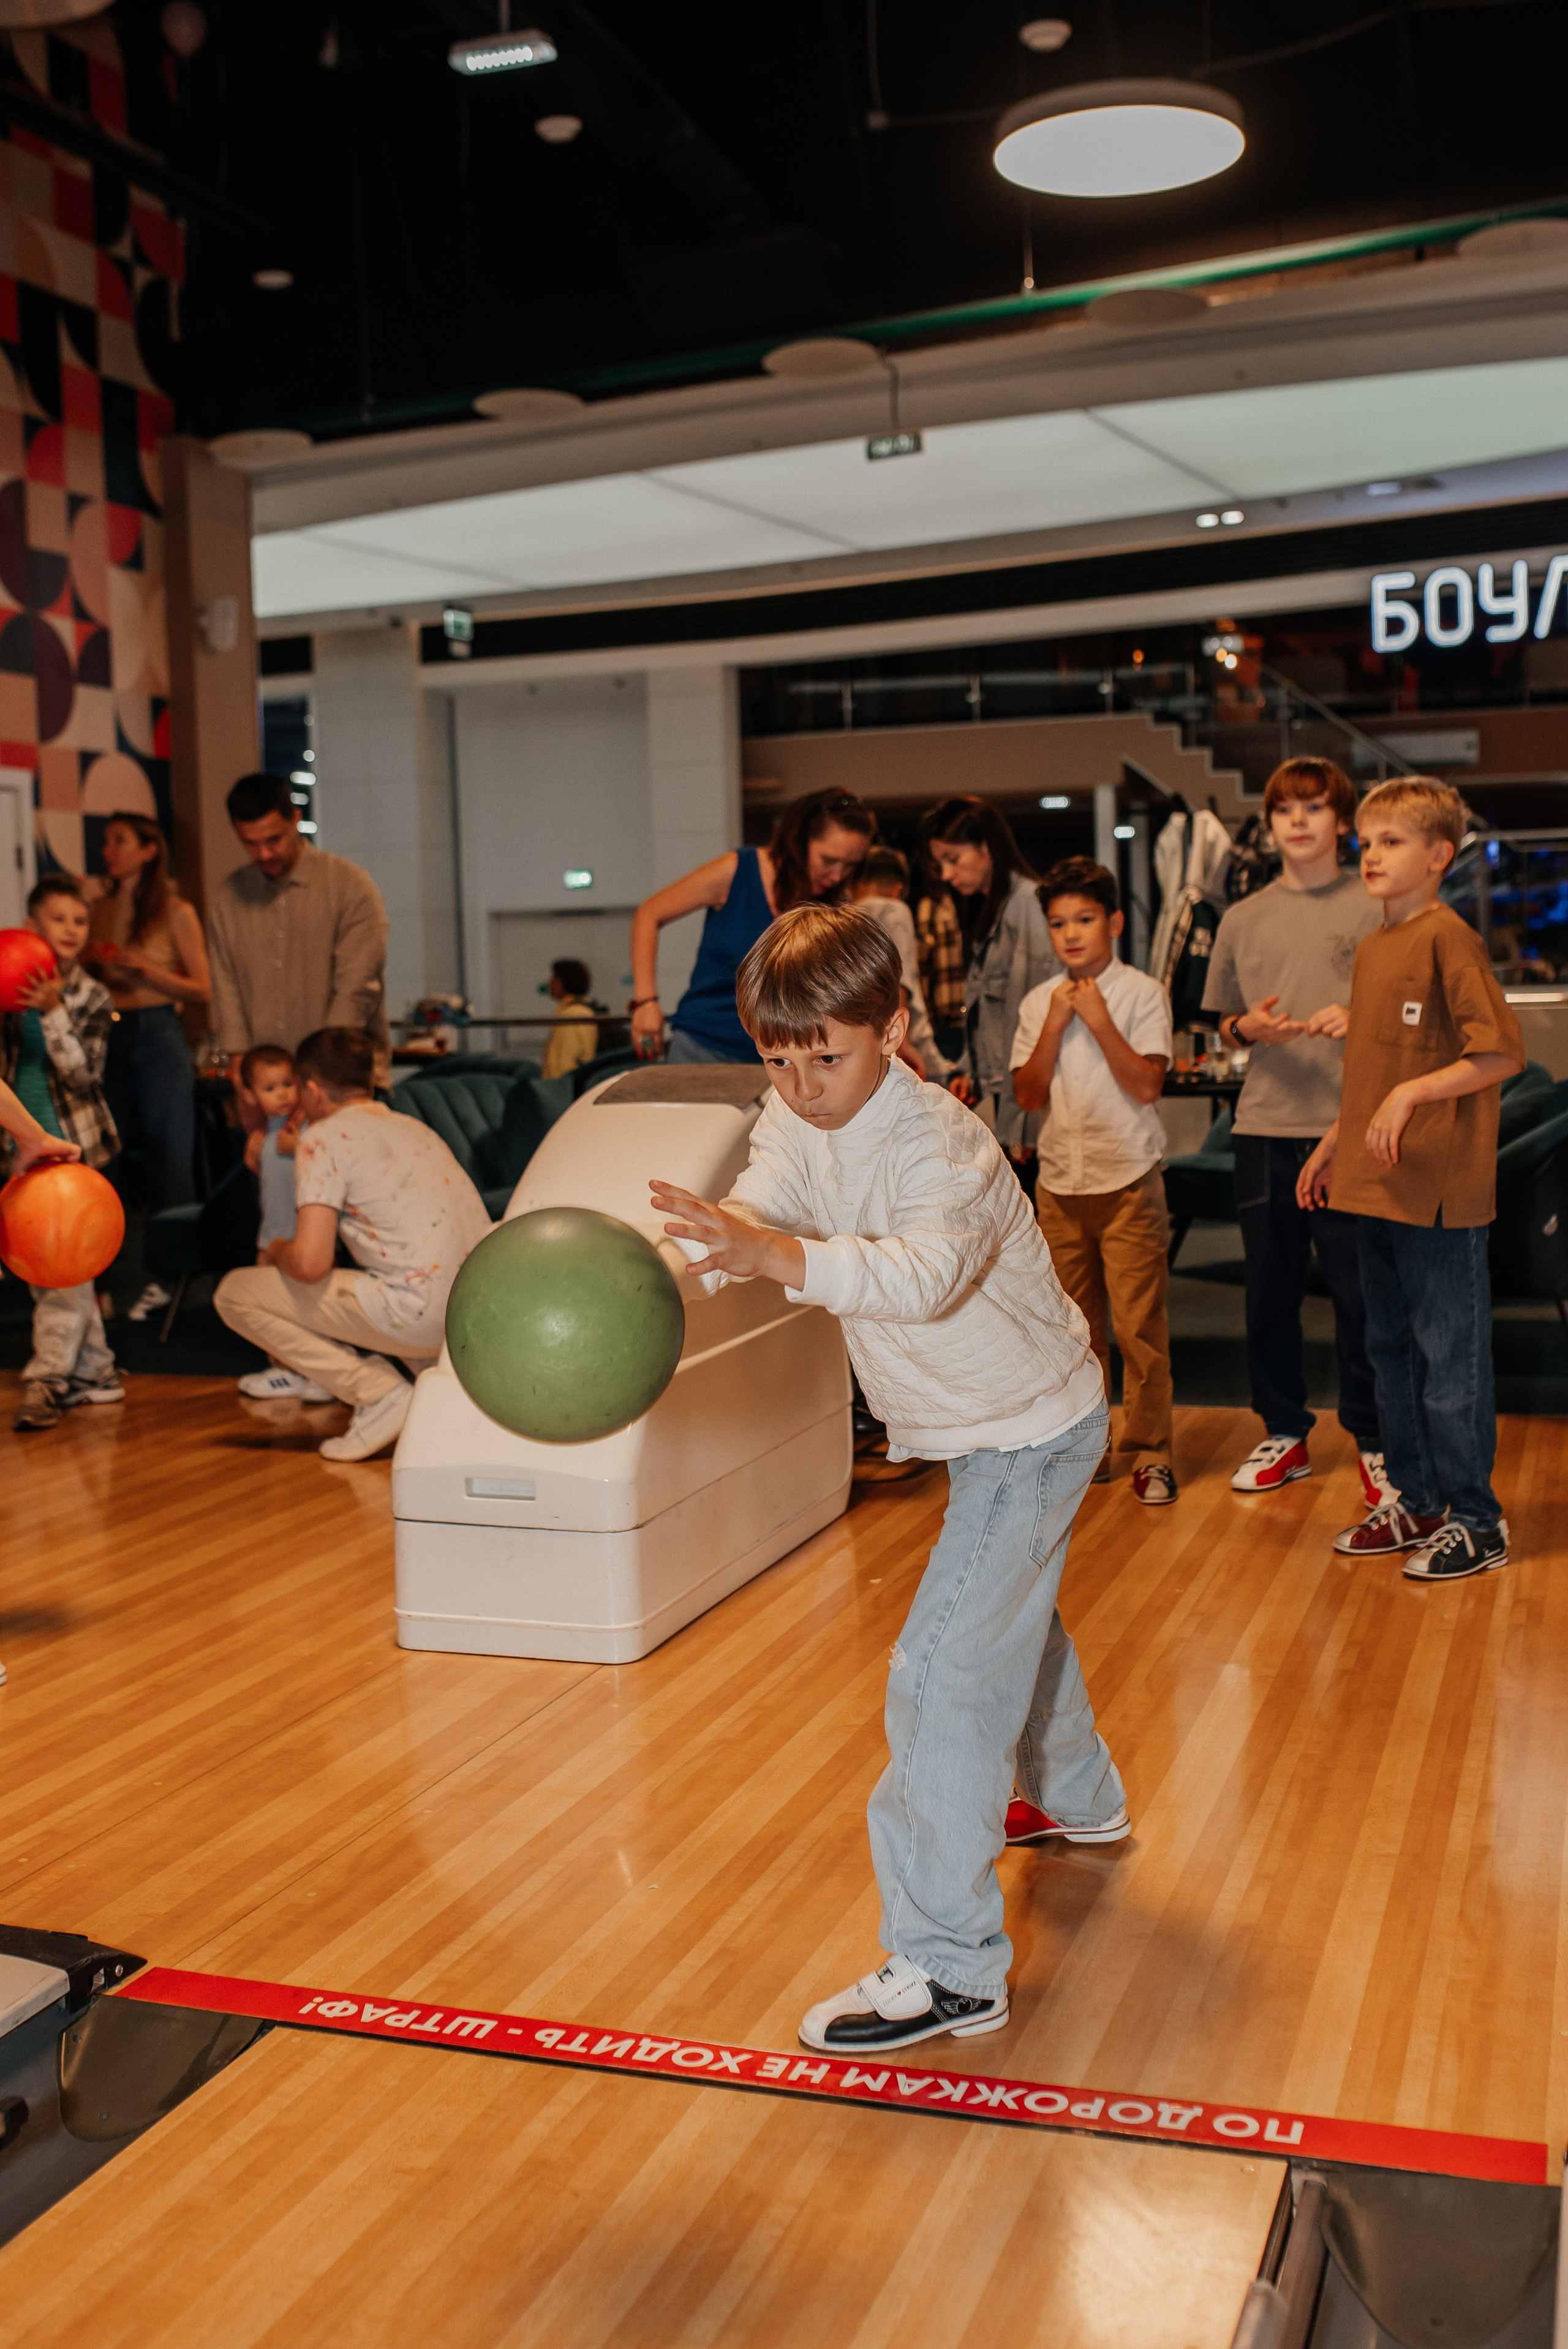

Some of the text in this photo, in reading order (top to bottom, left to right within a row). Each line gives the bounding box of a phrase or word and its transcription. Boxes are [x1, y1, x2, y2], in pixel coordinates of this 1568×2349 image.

[883, 1980, 916, 2007] LUCKY STRIKE
[298, 1996, 499, 2040] ШТРАФ!
[534, 2028, 753, 2074] ХОДИТЬ
[755, 2056, 831, 2084] НЕ
[839, 2067, 1203, 2130] ДОРОЖКАМ
[1213, 2113, 1305, 2145] ПО
